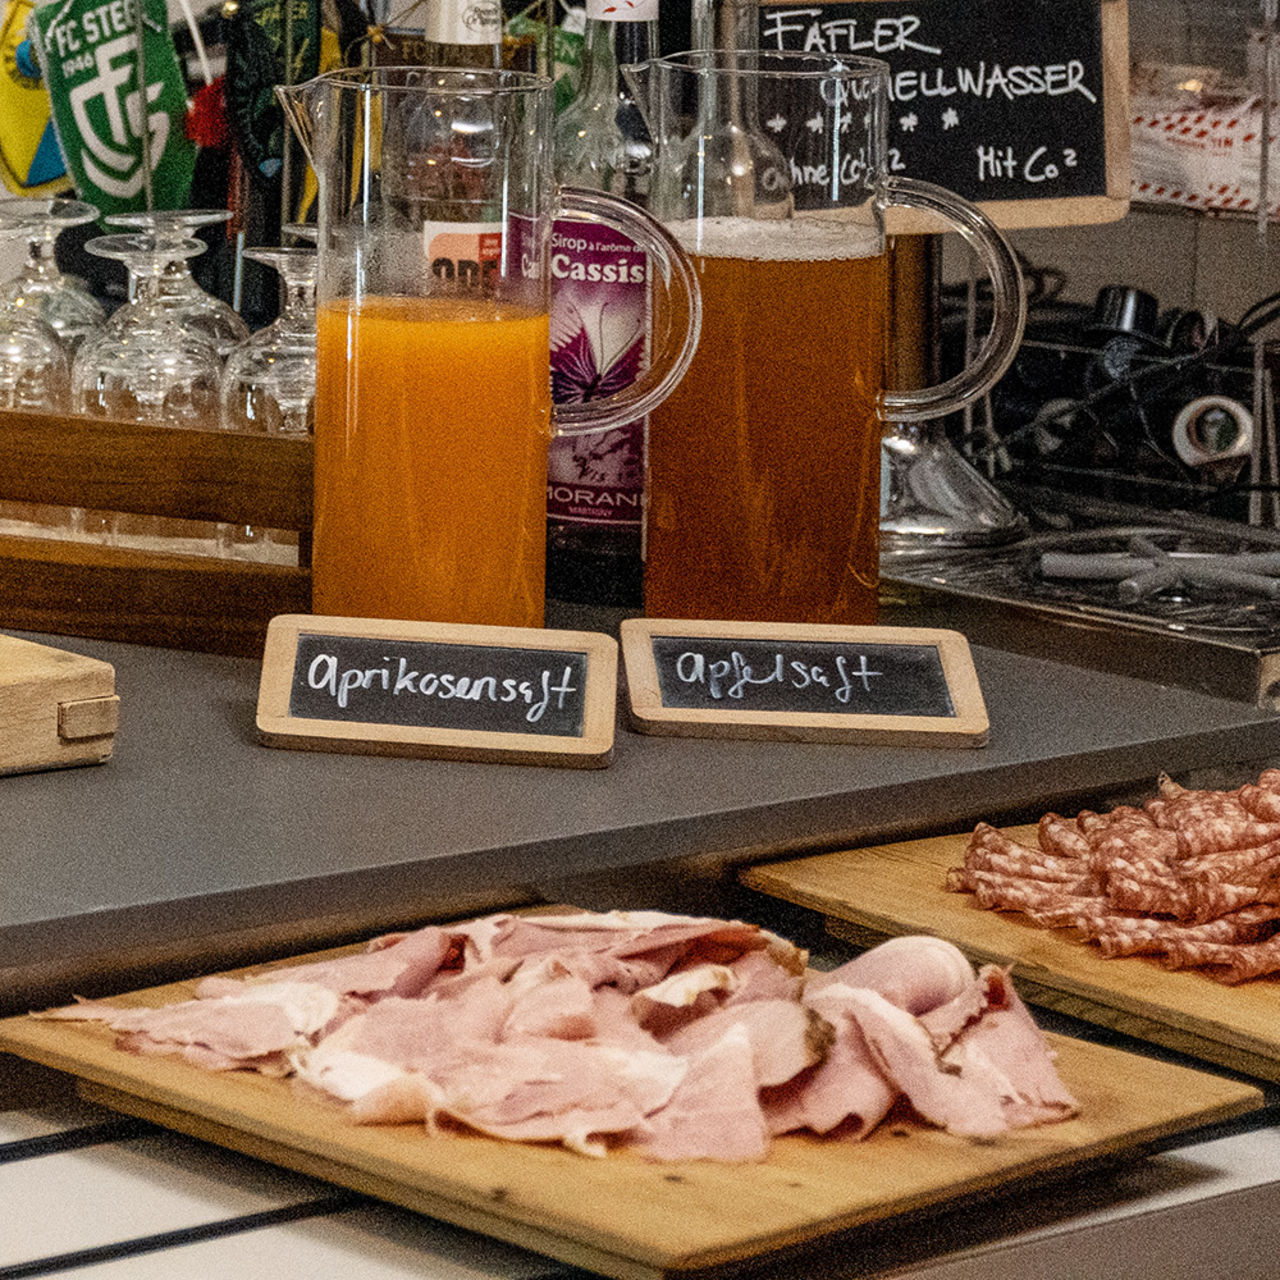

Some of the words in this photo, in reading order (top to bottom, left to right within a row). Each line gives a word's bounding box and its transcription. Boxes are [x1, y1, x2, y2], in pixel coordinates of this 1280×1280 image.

[55, 19, 82, 57] FC
[763, 9, 942, 55] FAFLER
[978, 145, 1018, 183] Mit
[550, 232, 588, 253] Sirop
[551, 253, 645, 283] Cassis
[547, 485, 643, 508] ORAN
